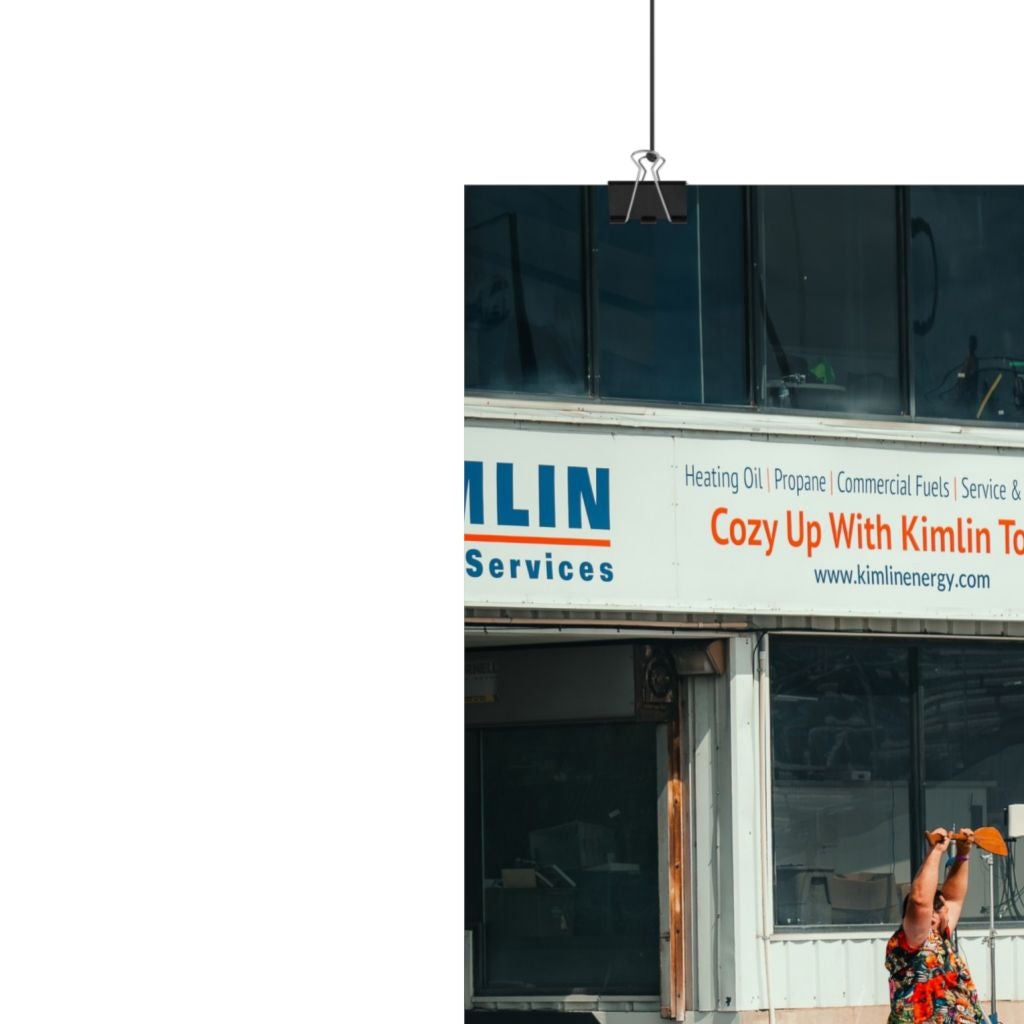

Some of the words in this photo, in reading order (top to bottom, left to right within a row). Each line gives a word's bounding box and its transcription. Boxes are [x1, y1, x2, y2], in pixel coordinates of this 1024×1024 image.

[685, 464, 739, 494] Heating
[743, 466, 763, 489] Oil
[774, 468, 826, 496] Propane
[837, 470, 912, 495] Commercial
[915, 475, 950, 498] Fuels
[961, 477, 1006, 500] Service
[1011, 479, 1021, 500] &
[711, 507, 778, 556] Cozy
[786, 510, 822, 558] Up
[828, 512, 892, 550] With
[901, 515, 991, 554] Kimlin
[465, 549, 614, 582] Services
[814, 564, 990, 592] www.kimlinenergy.com
